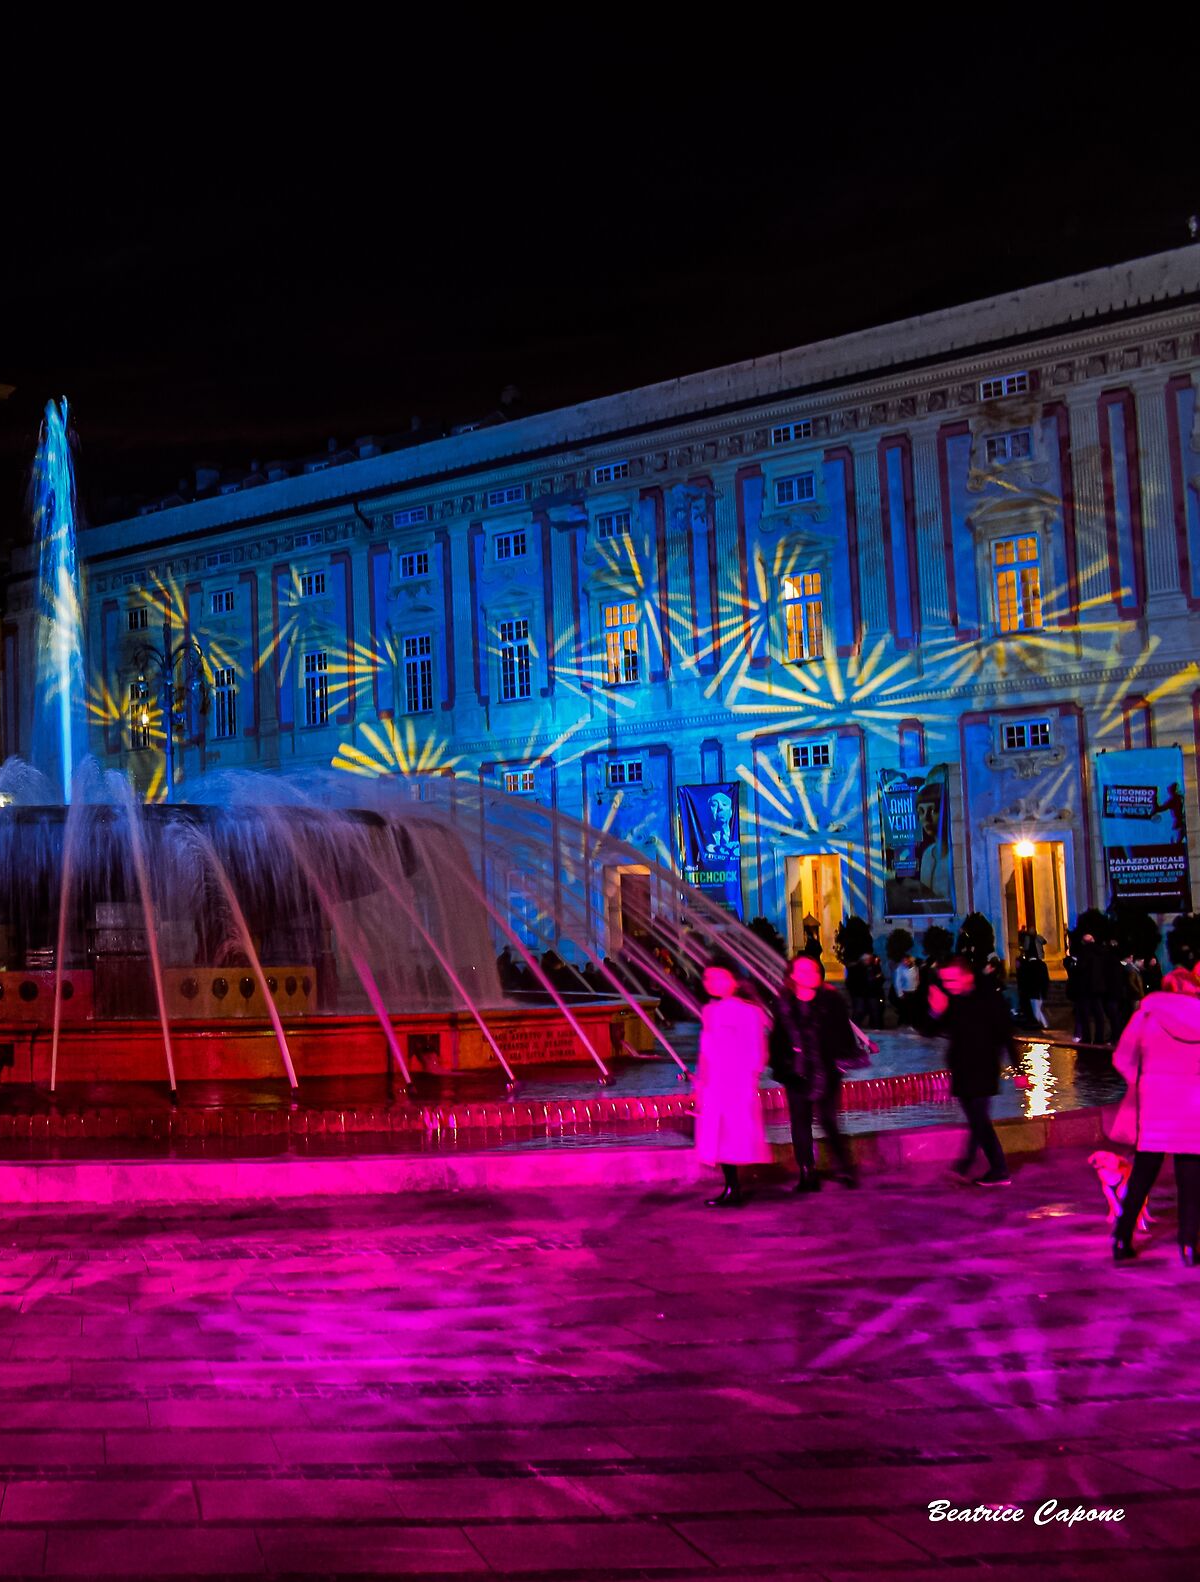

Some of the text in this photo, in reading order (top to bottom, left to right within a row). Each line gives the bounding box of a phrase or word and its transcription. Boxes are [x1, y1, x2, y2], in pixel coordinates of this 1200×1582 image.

[890, 797, 913, 814] ANNI
[888, 814, 916, 831] VENTI
[1109, 857, 1149, 865] PALAZZO
[1109, 863, 1185, 872] SOTTOPORTICATO
[684, 871, 737, 883] HITCHCOCK
